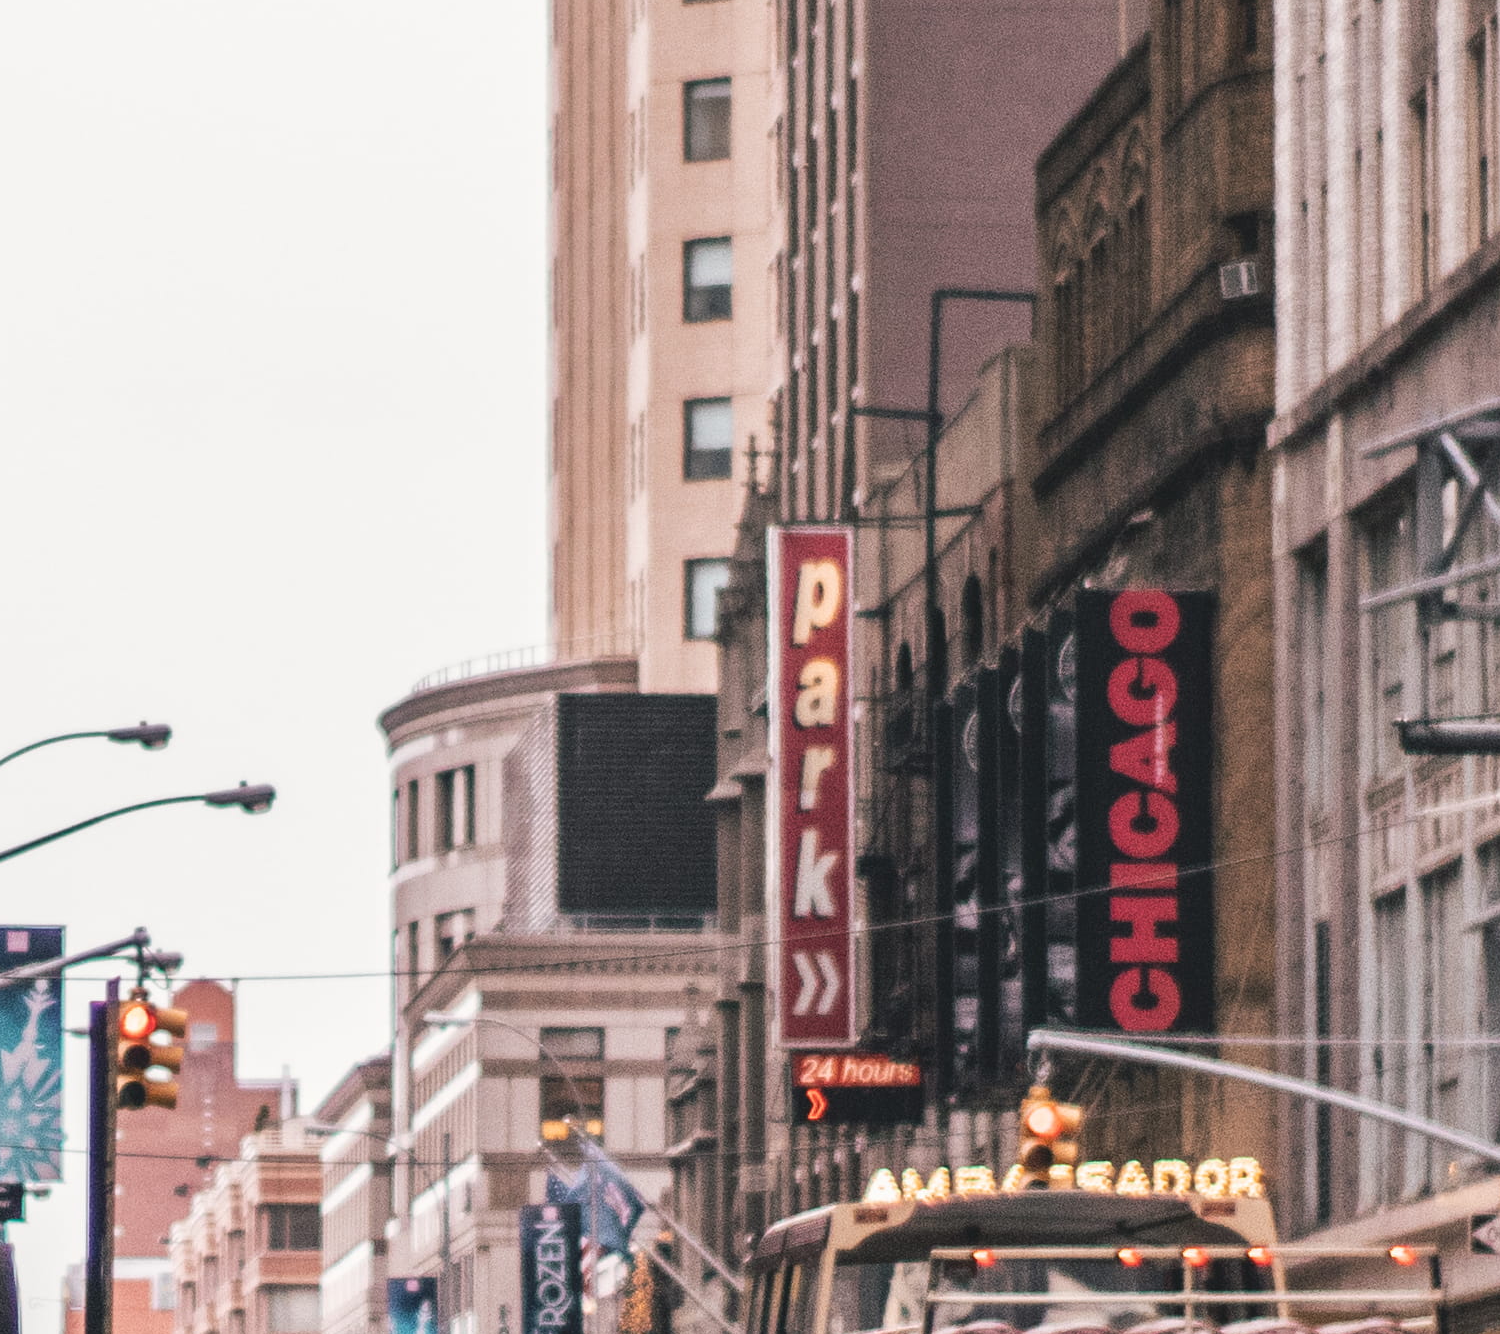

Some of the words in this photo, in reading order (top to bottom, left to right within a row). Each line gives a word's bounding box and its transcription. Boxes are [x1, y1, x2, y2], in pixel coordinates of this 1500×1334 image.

[792, 556, 844, 919] park
[1107, 588, 1181, 1032] CHICAGO
[800, 1058, 833, 1083] 24
[842, 1057, 914, 1084] hours
